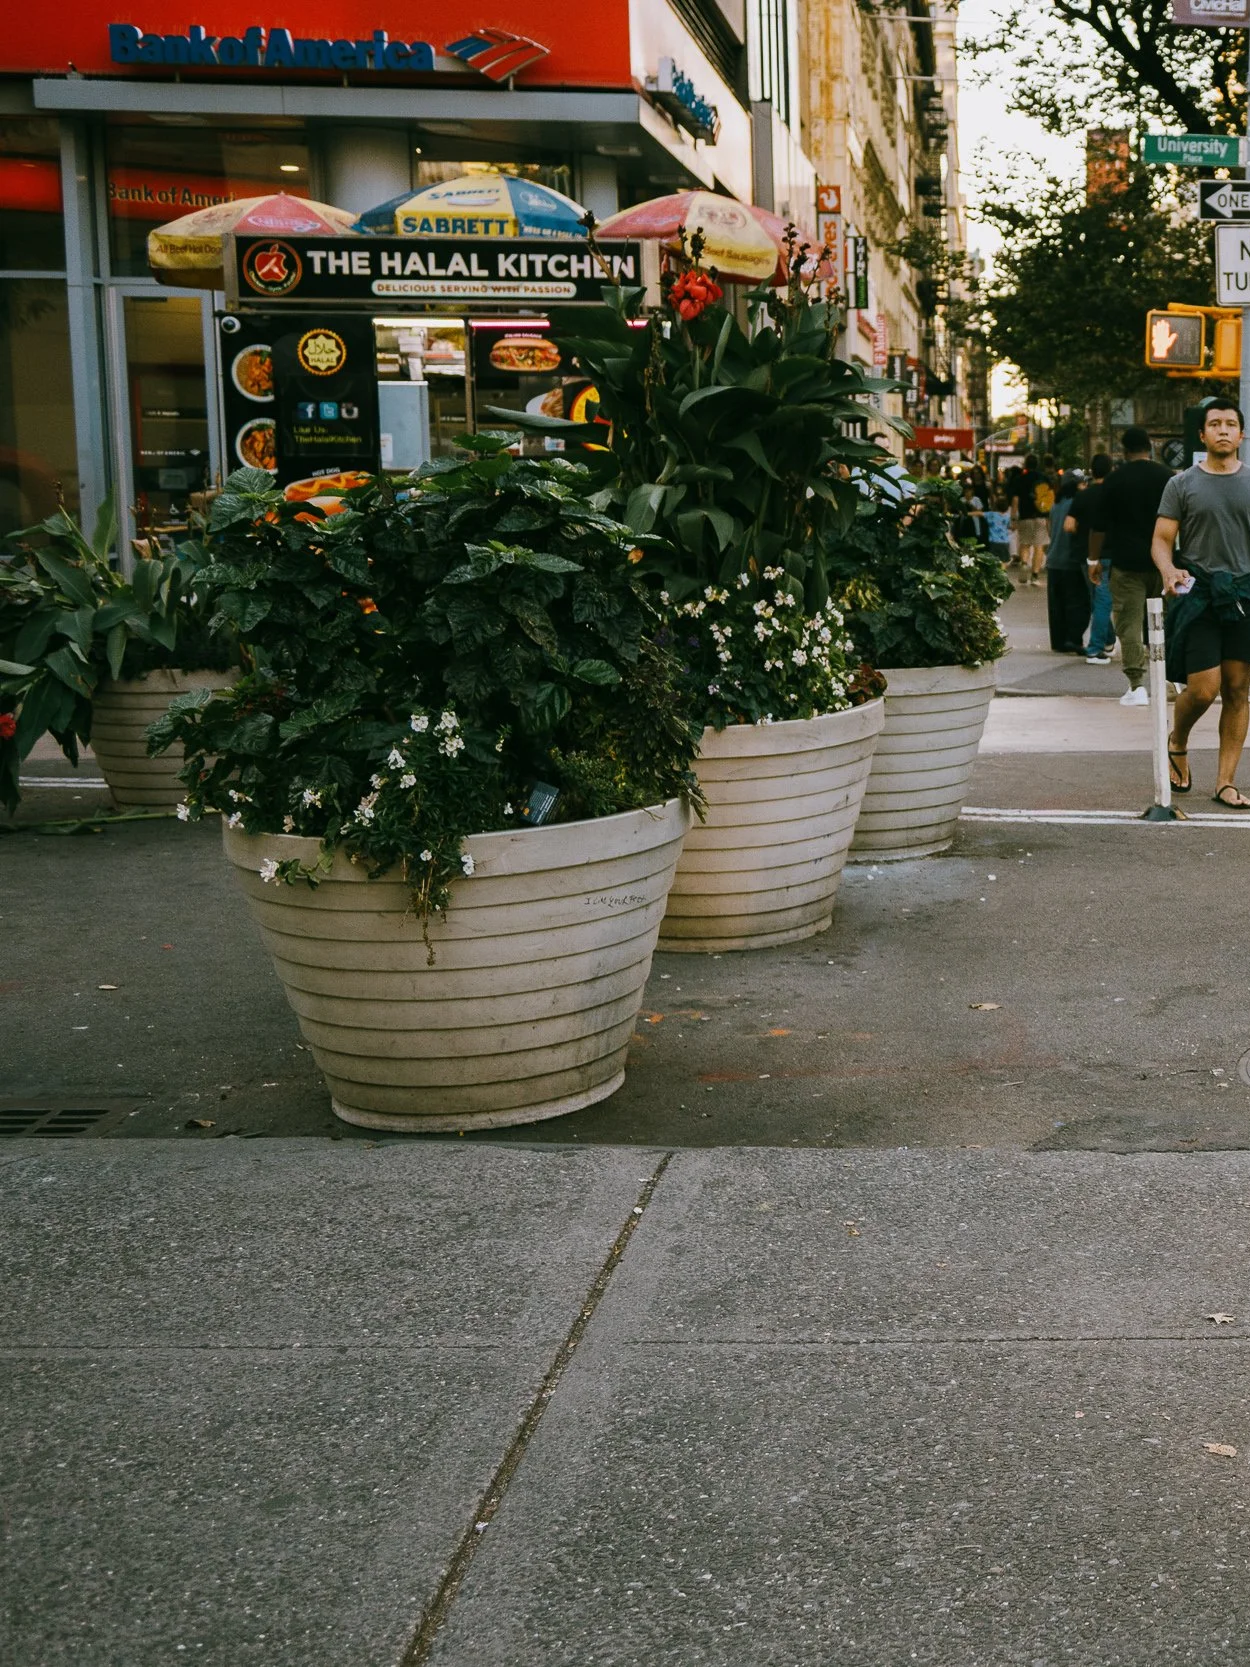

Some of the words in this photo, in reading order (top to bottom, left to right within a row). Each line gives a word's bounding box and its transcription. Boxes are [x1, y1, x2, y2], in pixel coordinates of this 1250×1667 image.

[108, 23, 219, 64] Bank
[218, 26, 267, 67] of
[264, 28, 436, 70] America
[1157, 136, 1229, 158] University
[1183, 153, 1203, 163] Place
[157, 185, 177, 204] of
[1217, 193, 1250, 208] ONE
[402, 216, 509, 235] SABRETT
[204, 244, 222, 256] Dog
[306, 250, 371, 275] THE
[380, 251, 489, 276] HALAL
[497, 253, 635, 279] KITCHEN
[376, 284, 437, 293] DELICIOUS
[440, 284, 488, 294] SERVING
[490, 285, 521, 294] WITH
[523, 285, 571, 294] PASSION
[310, 356, 335, 364] HALAL
